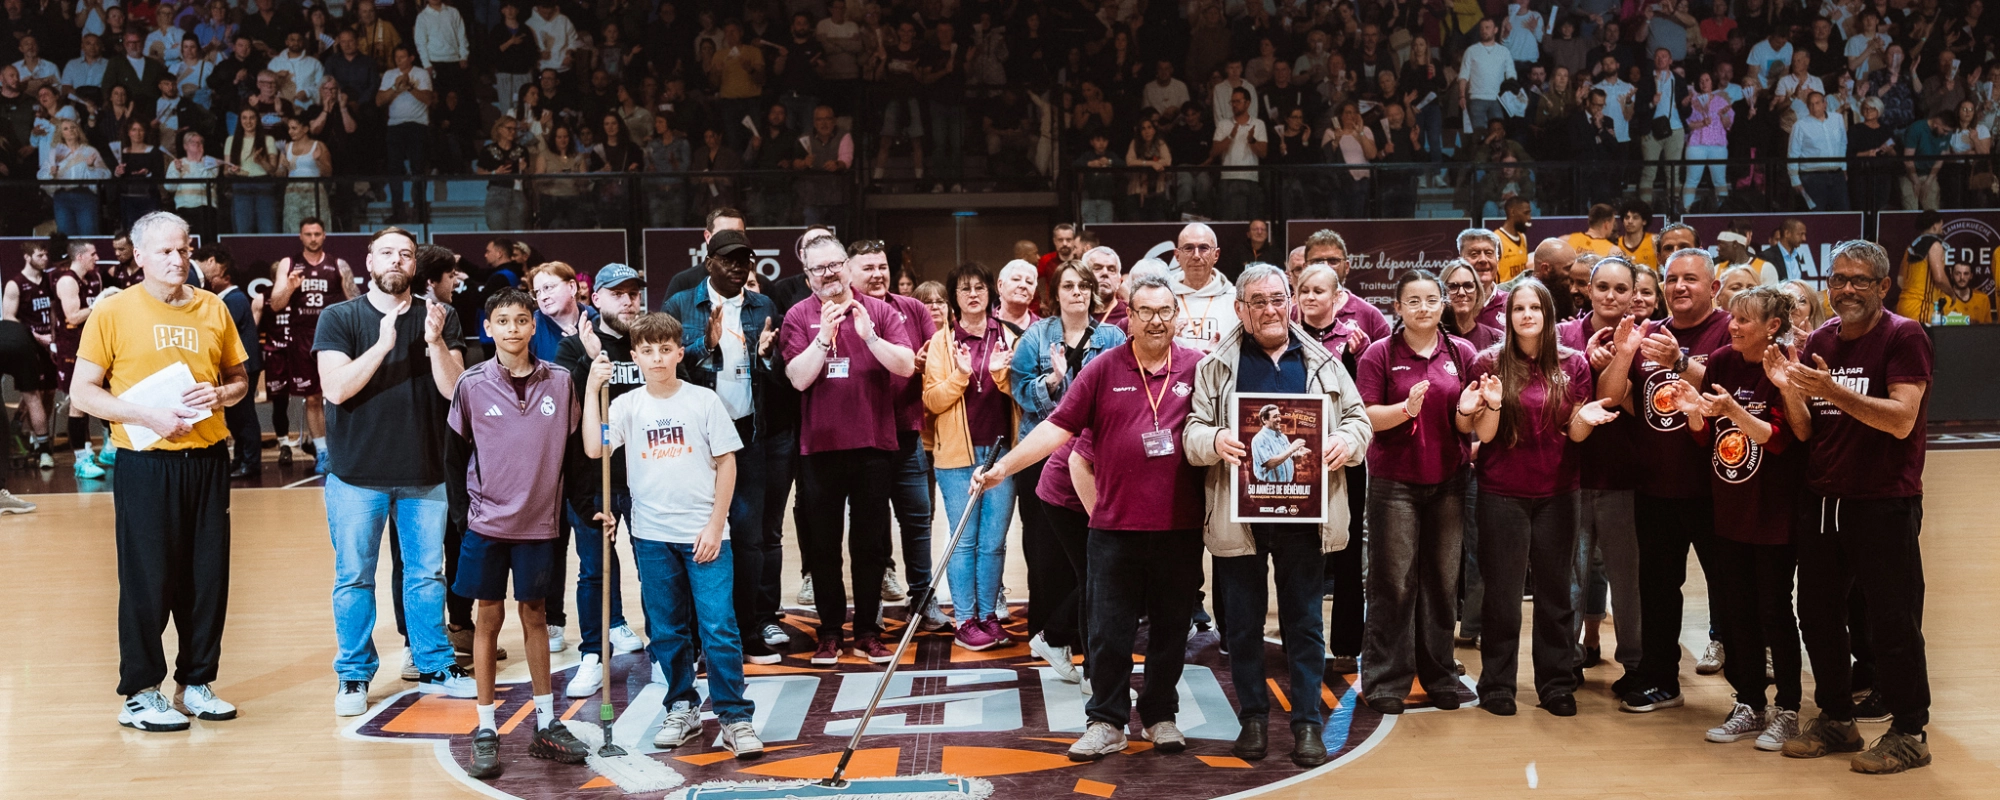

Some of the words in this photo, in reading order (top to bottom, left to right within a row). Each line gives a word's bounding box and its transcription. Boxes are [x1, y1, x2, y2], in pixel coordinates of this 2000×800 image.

[301, 279, 328, 292] ASA
[306, 293, 323, 307] 33
[153, 324, 199, 354] ASA
[646, 426, 685, 449] ASA
[652, 447, 683, 460] FAMILY
[1247, 484, 1255, 494] 50
[1256, 483, 1275, 494] ANNÉES
[1276, 484, 1283, 494] DE
[1283, 483, 1311, 495] BÉNÉVOLAT
